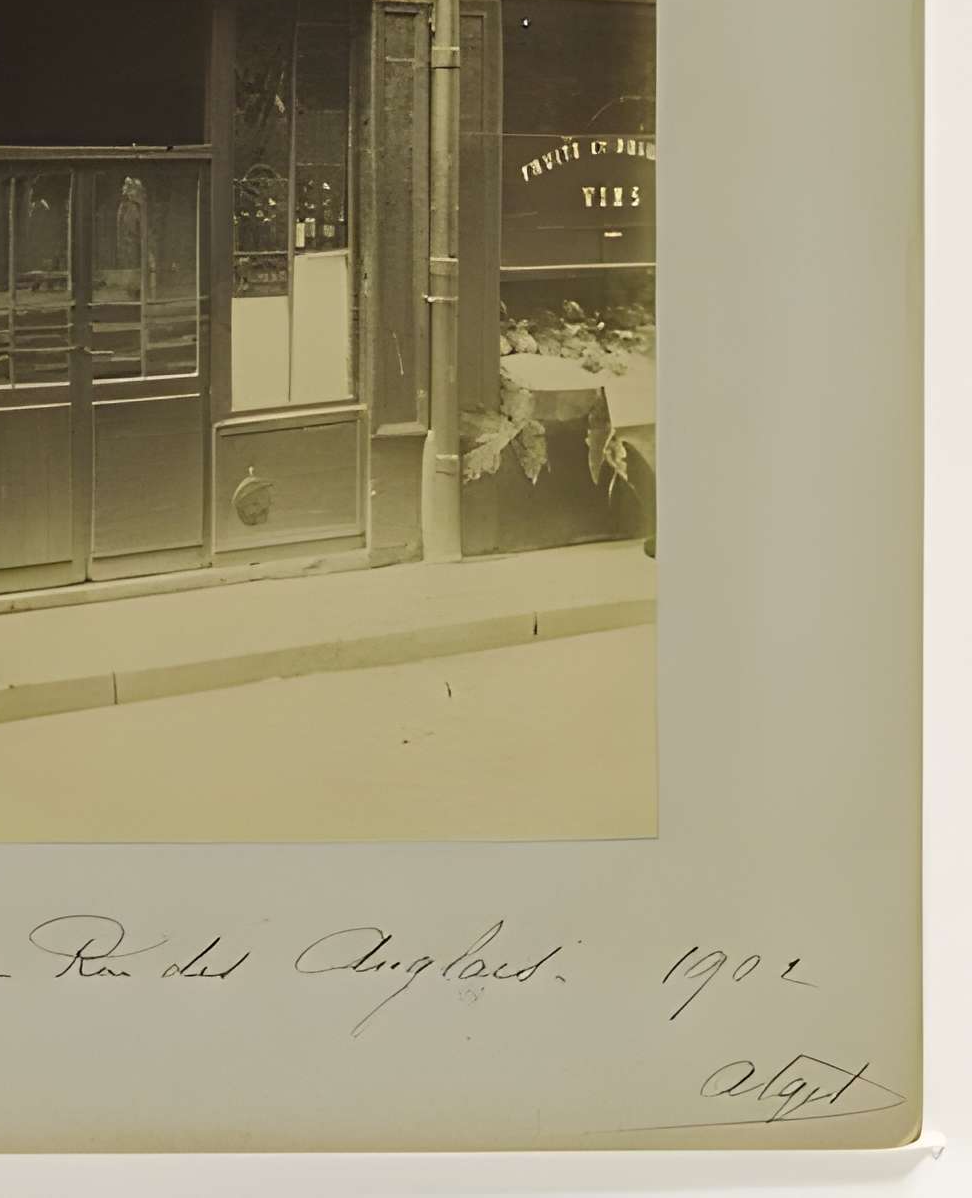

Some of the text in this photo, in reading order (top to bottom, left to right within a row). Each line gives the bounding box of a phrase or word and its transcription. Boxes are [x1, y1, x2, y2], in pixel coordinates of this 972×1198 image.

[29, 915, 168, 979] Rue
[161, 937, 250, 980] des
[662, 946, 819, 1021] 1902
